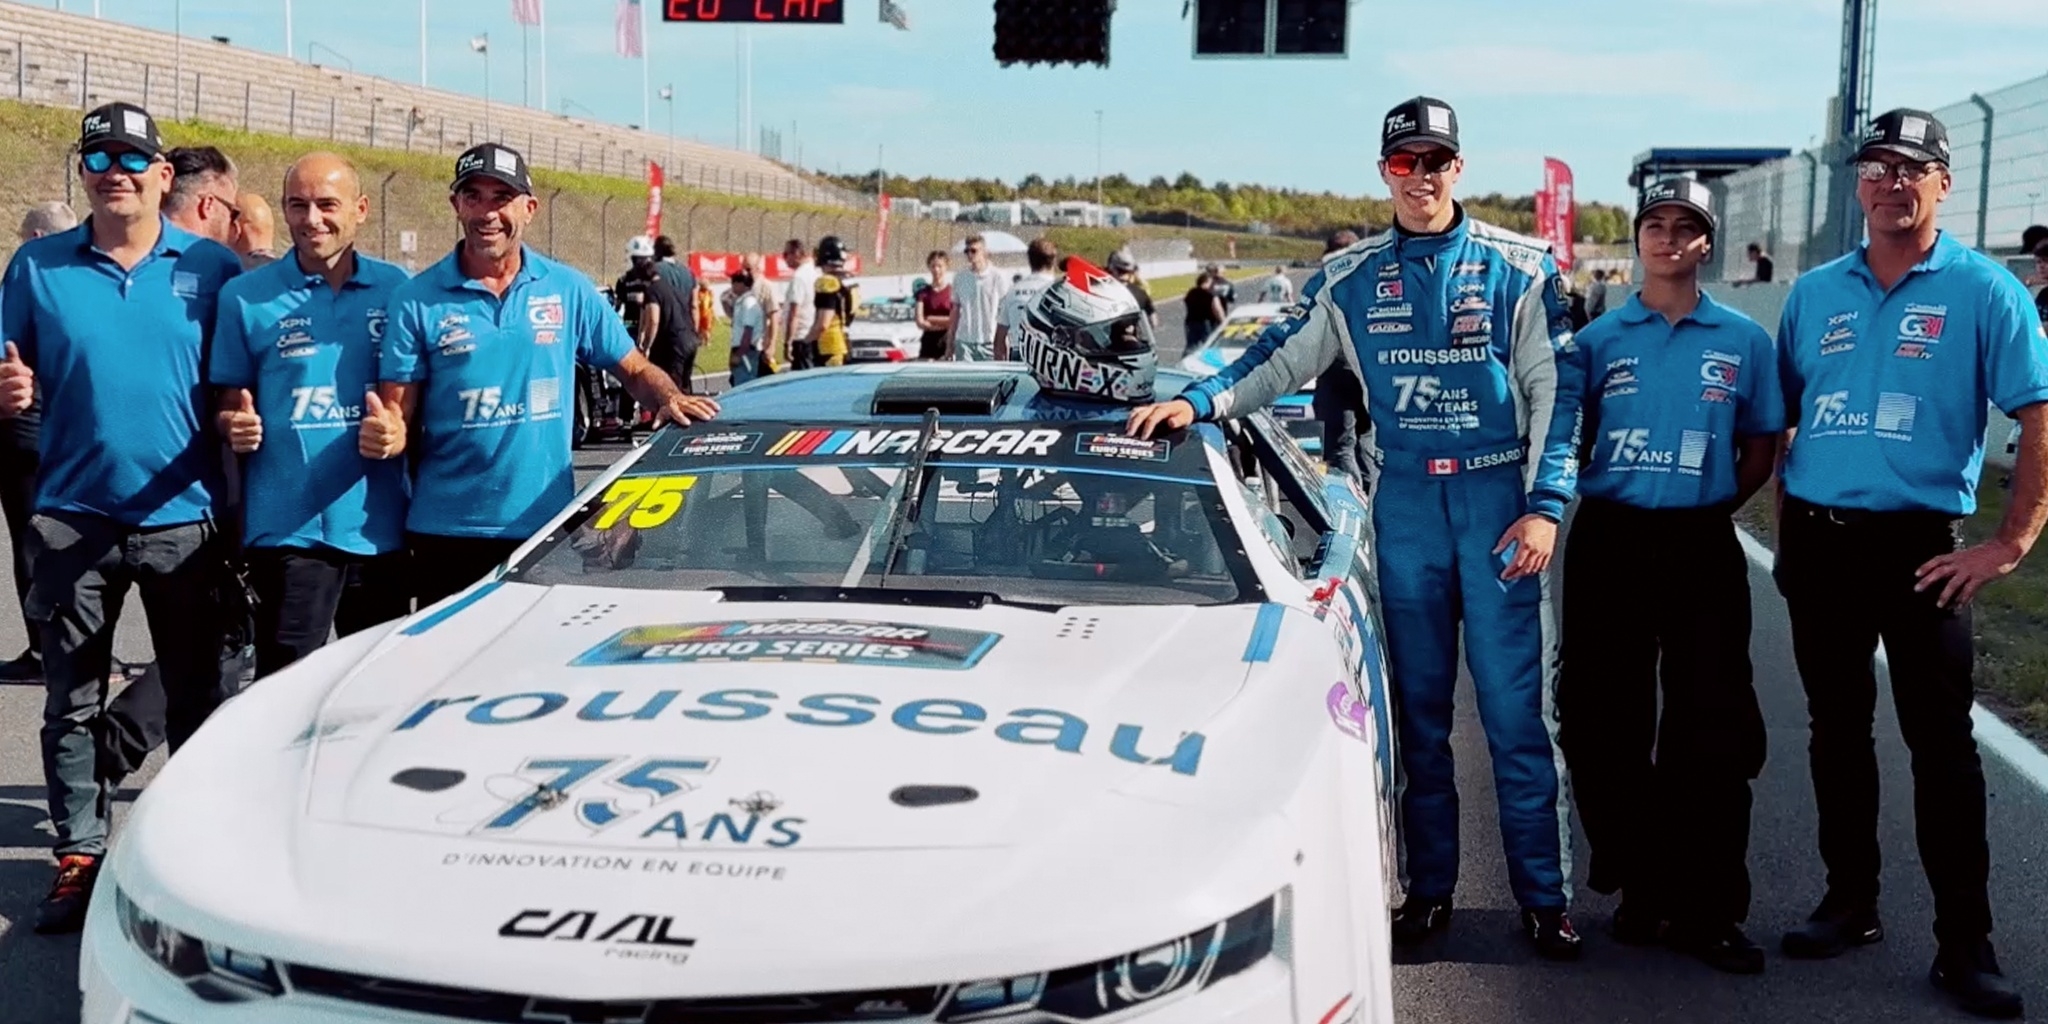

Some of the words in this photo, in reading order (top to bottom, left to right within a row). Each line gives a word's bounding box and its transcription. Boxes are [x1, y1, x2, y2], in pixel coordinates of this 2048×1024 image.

[279, 317, 313, 330] XPN
[1391, 347, 1487, 365] rousseau
[291, 385, 338, 422] 75
[327, 405, 361, 419] ANS
[458, 386, 502, 421] 75
[495, 402, 526, 418] ANS
[1392, 375, 1441, 412] 75
[1441, 388, 1469, 401] ANS
[1435, 401, 1479, 412] YEARS
[1811, 390, 1849, 430] 75
[1836, 412, 1869, 426] ANS
[836, 429, 1061, 457] NASCAR
[1090, 445, 1118, 453] EURO
[1119, 447, 1154, 458] SERIES
[1607, 428, 1650, 463] 75
[1637, 450, 1673, 464] ANS
[594, 476, 698, 529] 75
[742, 620, 930, 642] NASCAR
[640, 641, 758, 657] EURO
[761, 639, 914, 659] SERIES
[390, 688, 1207, 777] rousseau
[485, 757, 710, 829] 75
[640, 810, 806, 848] ANS
[442, 852, 633, 870] D'INNOVATION
[642, 858, 678, 873] EN
[604, 948, 690, 967] racing
